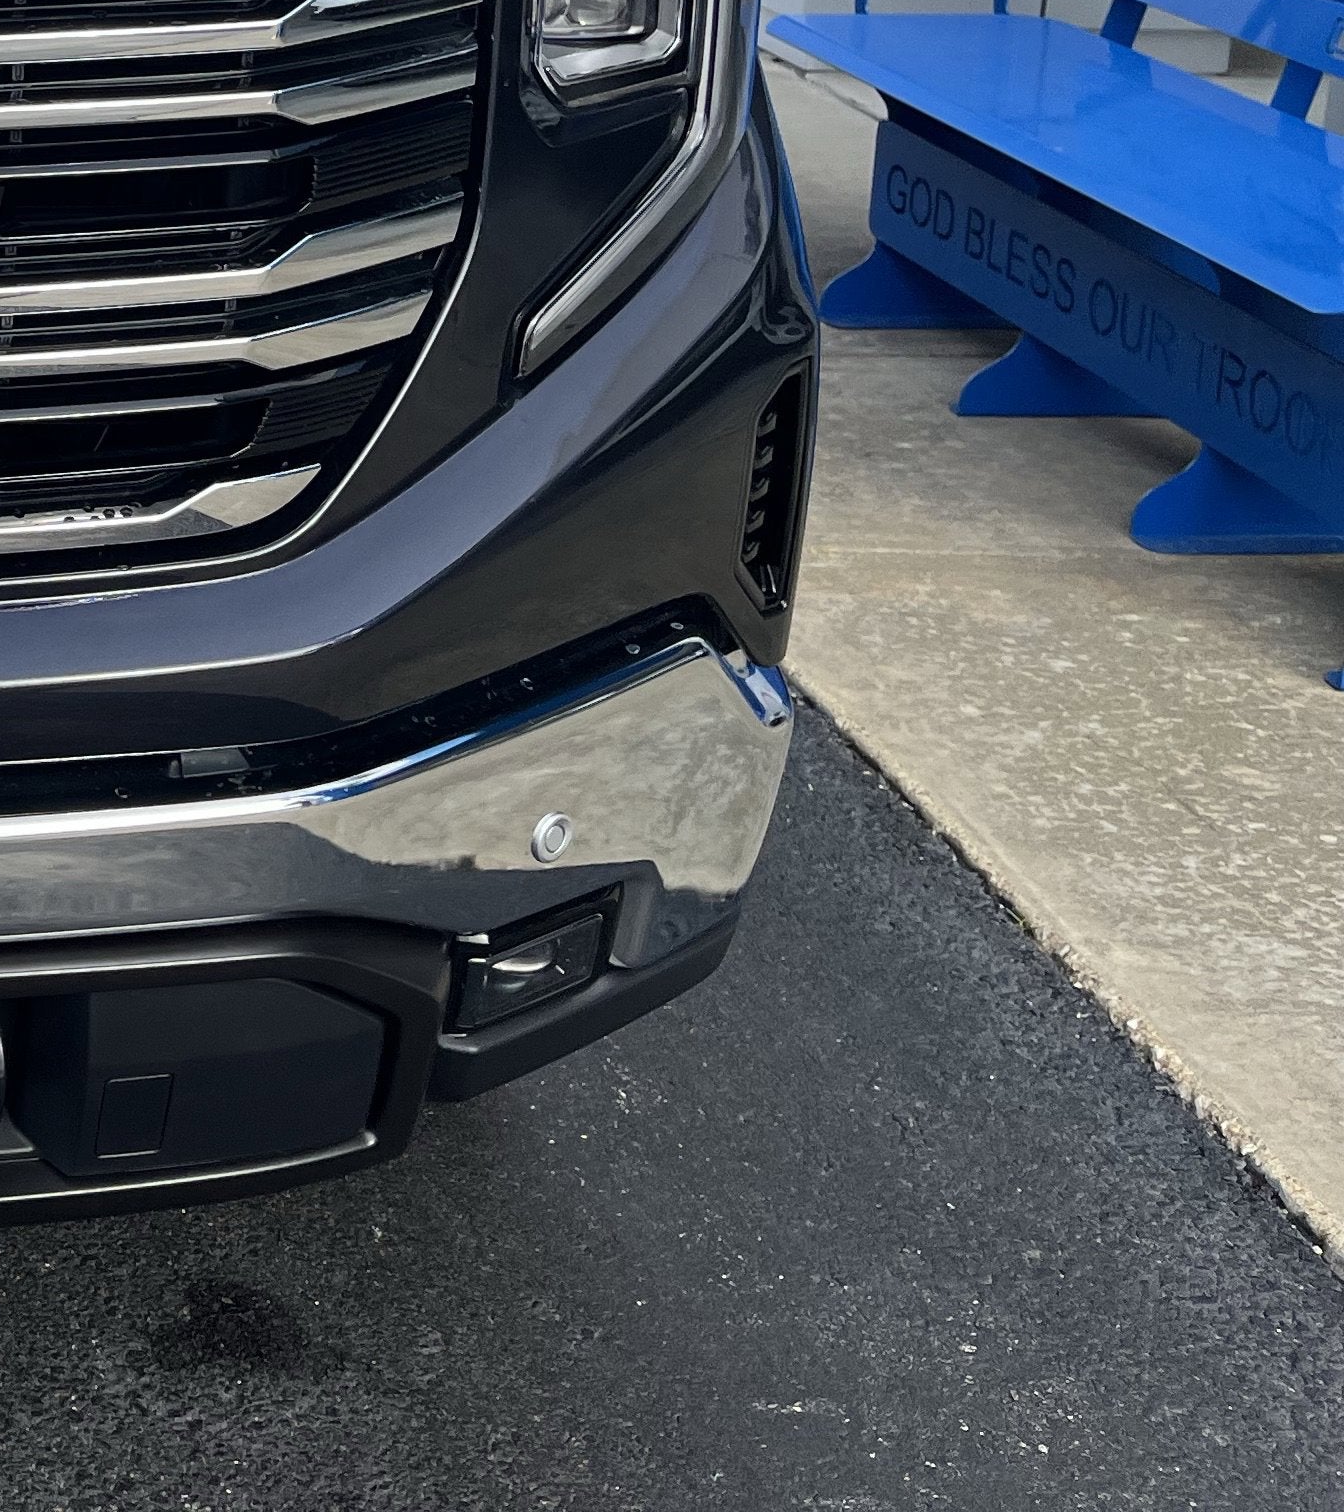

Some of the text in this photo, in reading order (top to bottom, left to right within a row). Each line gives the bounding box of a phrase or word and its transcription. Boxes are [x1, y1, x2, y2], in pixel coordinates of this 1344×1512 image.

[886, 163, 955, 242] GOD
[964, 205, 1078, 315] BLESS
[1087, 277, 1178, 378] OUR
